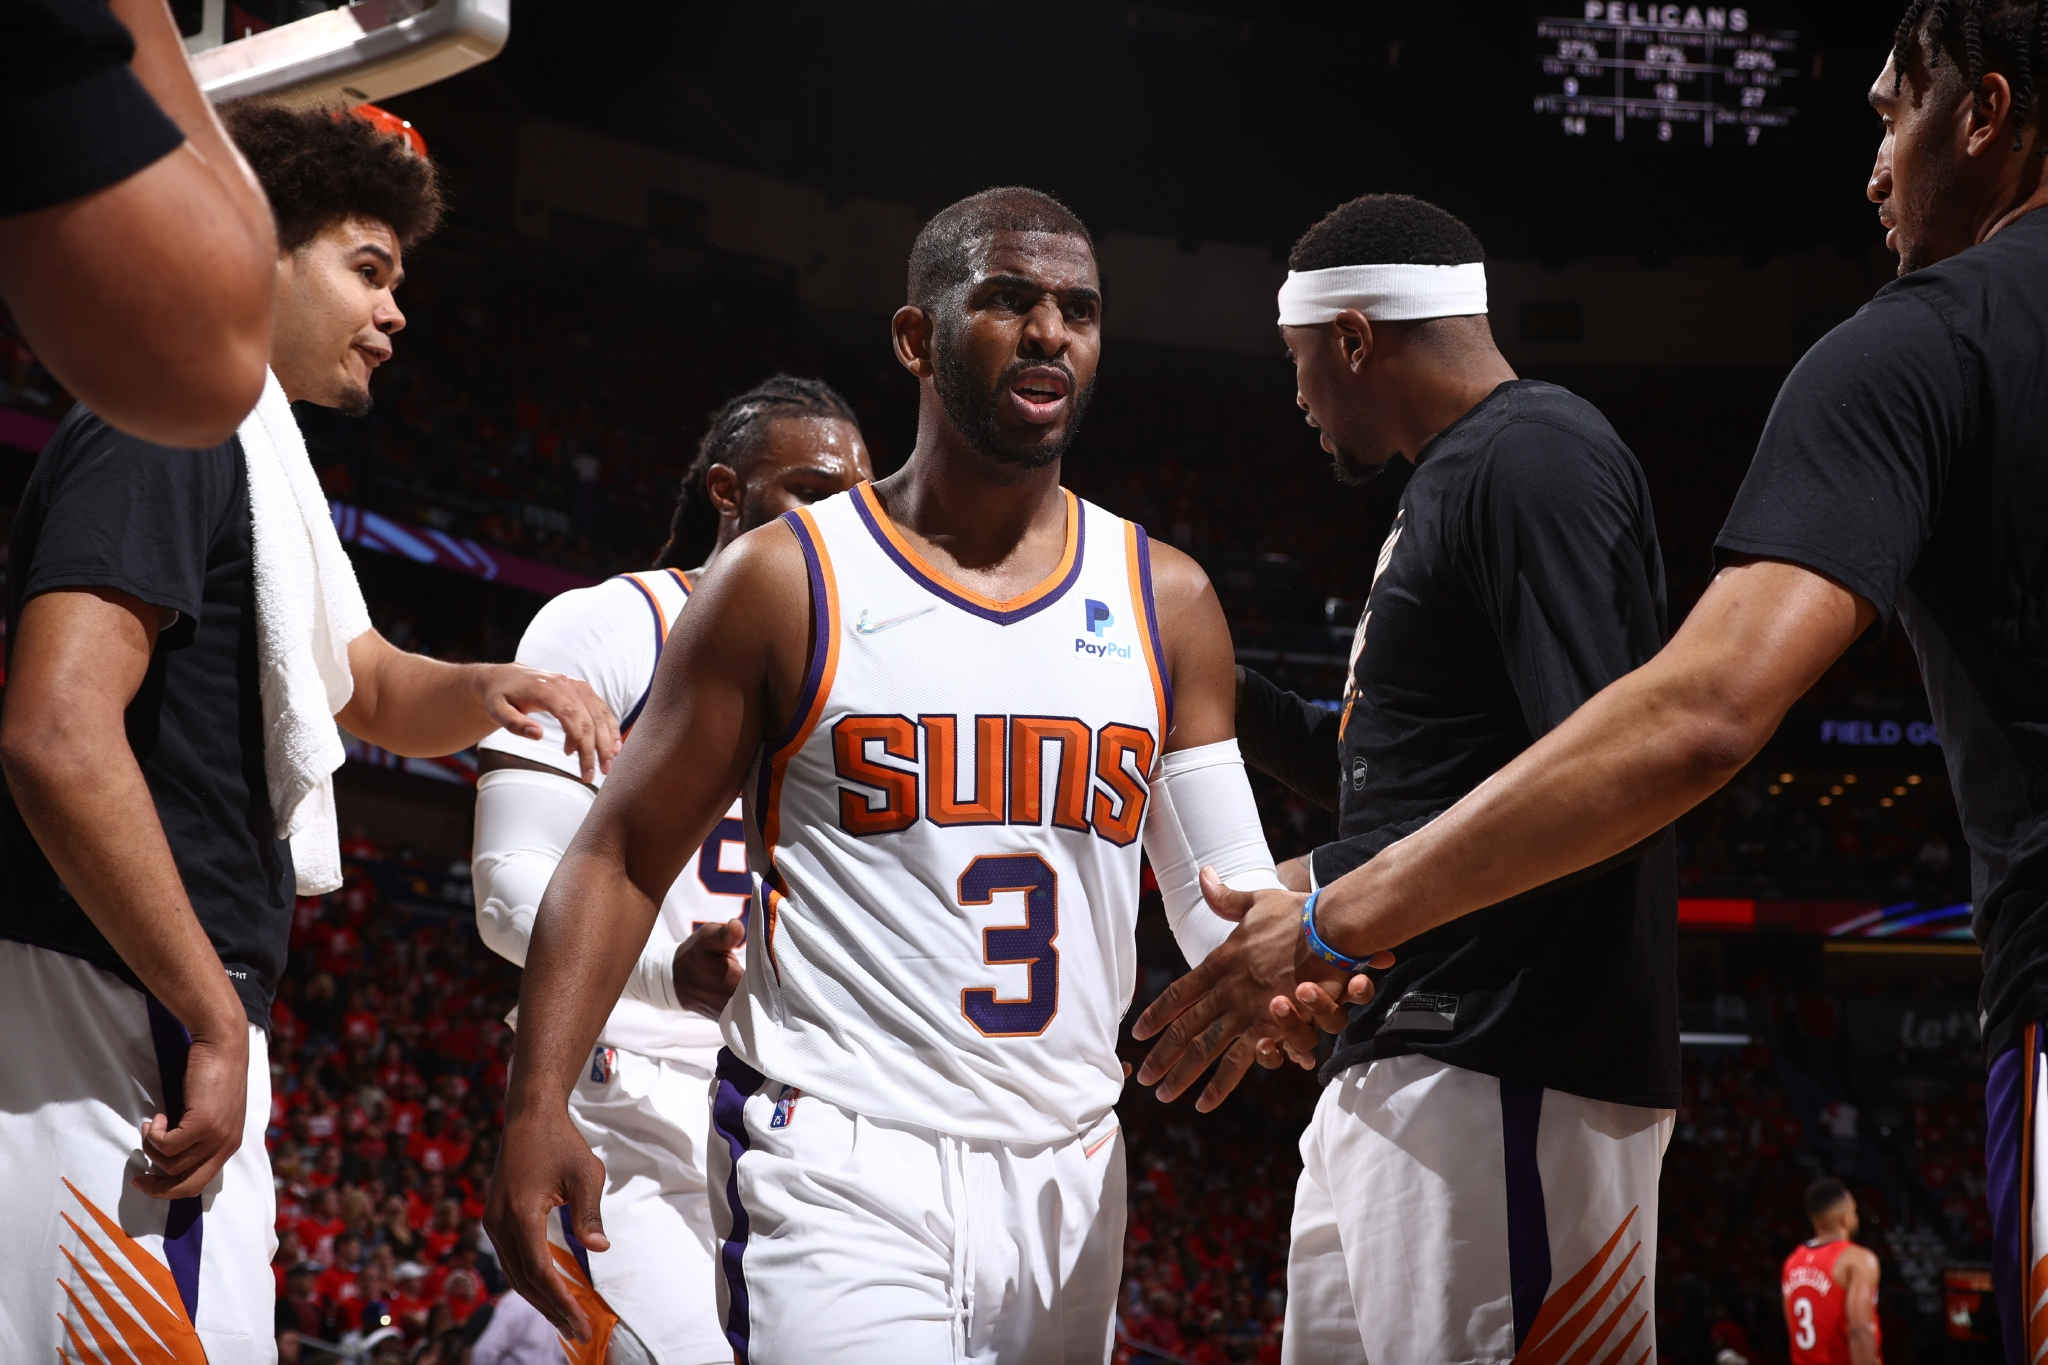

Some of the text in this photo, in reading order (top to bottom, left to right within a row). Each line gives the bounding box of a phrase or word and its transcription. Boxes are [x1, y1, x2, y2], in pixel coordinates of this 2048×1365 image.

[1584, 0, 1749, 32] PELICANS
[1657, 121, 1673, 142] 3
[1745, 125, 1761, 147] 7
[1075, 638, 1131, 659] PayPal
[1820, 719, 1902, 746] FIELD
[831, 713, 1156, 848] SUNS
[957, 852, 1059, 1038] 3
[1793, 1296, 1816, 1351] 3
